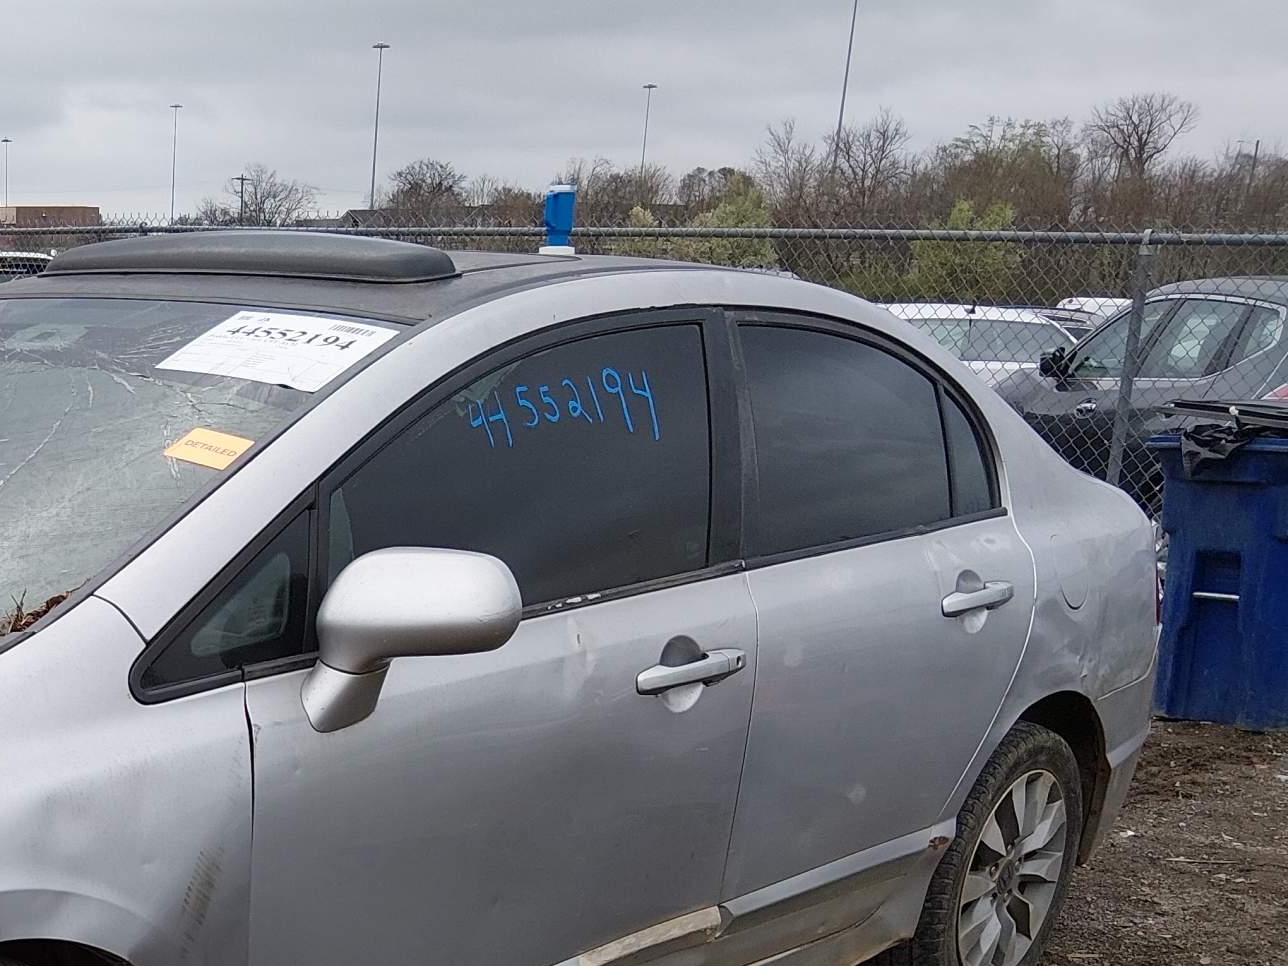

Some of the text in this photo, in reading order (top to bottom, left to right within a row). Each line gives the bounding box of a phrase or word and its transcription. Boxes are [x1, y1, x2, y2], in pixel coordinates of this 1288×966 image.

[227, 324, 358, 351] 44552194
[466, 367, 660, 448] 44552194
[184, 439, 238, 457] DETAILED
